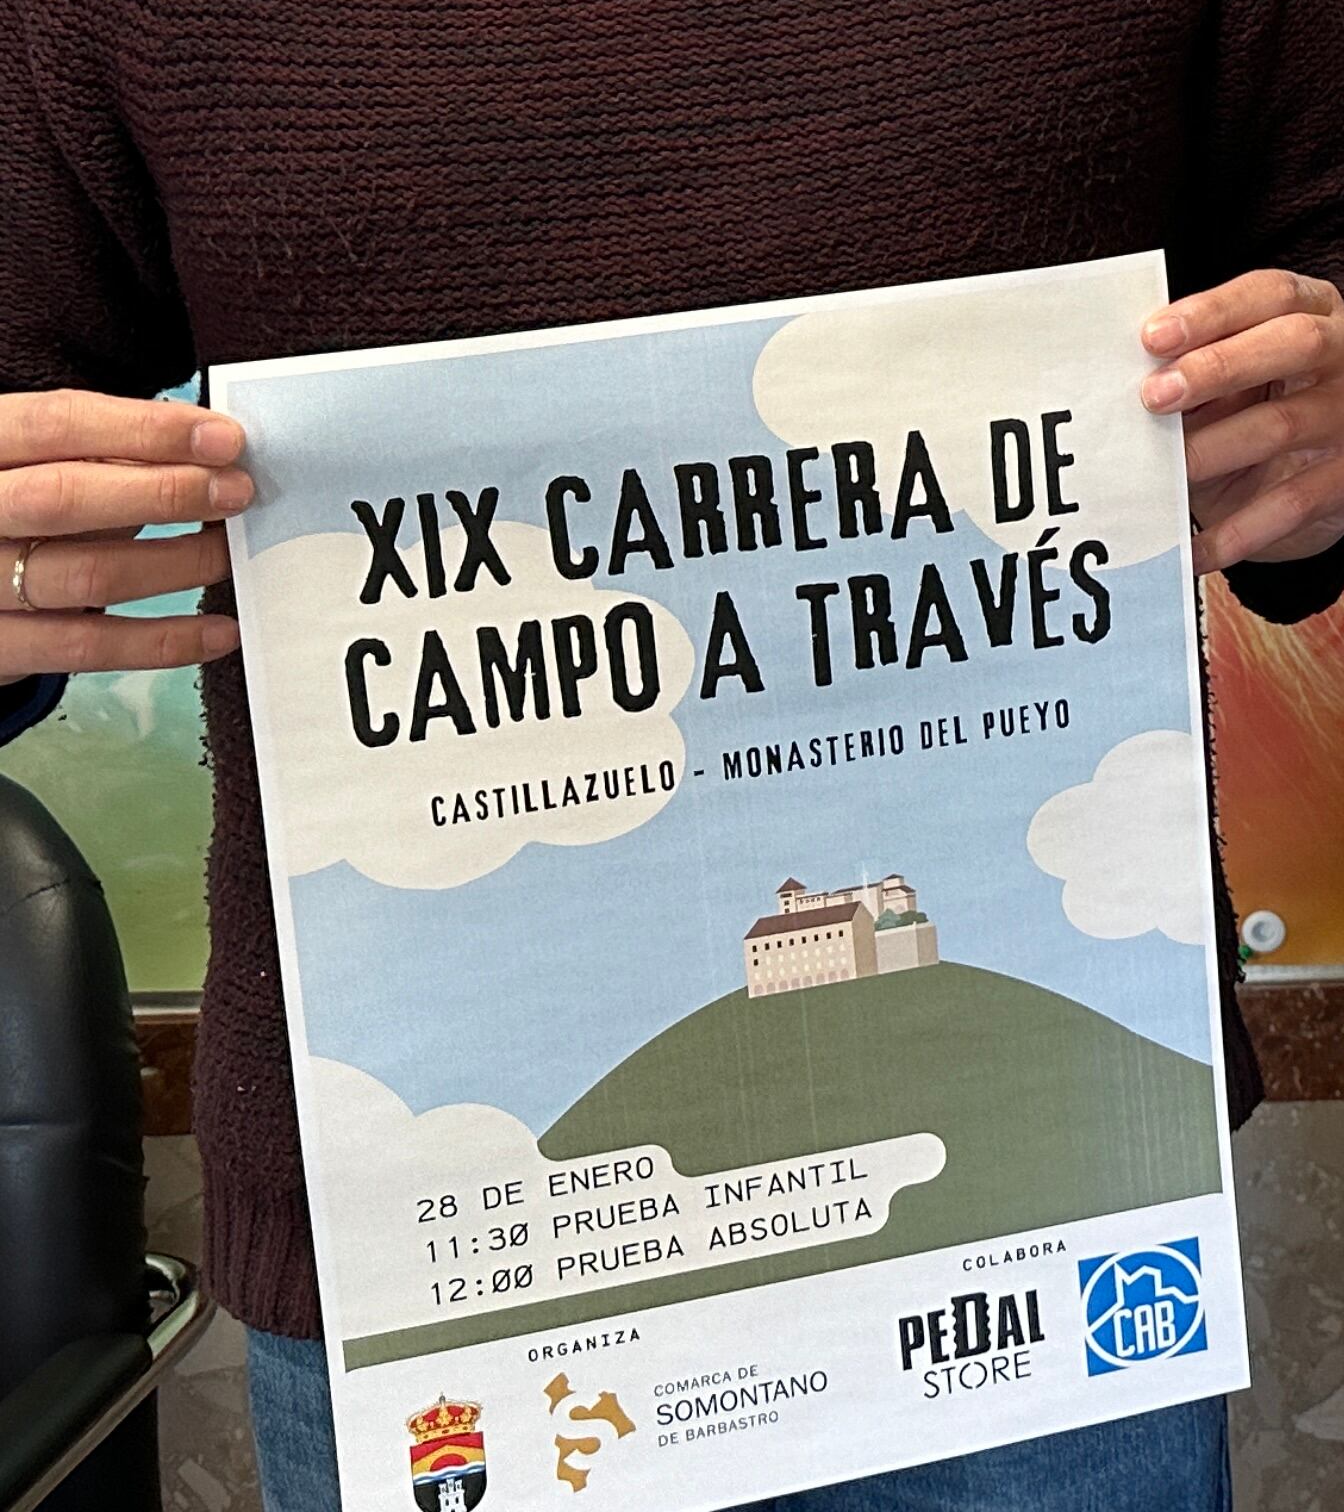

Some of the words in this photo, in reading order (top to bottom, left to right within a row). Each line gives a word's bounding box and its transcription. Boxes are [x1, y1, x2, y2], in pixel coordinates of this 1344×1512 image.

[350, 486, 512, 605] XIX
[545, 430, 955, 580] CARRERA
[990, 409, 1080, 525] DE
[344, 601, 661, 748] CAMPO
[699, 590, 766, 700] A
[796, 528, 1112, 688] TRAVÉS
[431, 760, 675, 827] CASTILLAZUELO
[722, 724, 904, 781] MONASTERIO
[920, 715, 968, 750] DEL
[982, 699, 1070, 740] PUEYO
[417, 1194, 458, 1223] 28
[482, 1180, 524, 1211] DE
[548, 1156, 654, 1197] ENERO
[427, 1222, 528, 1263] 11:30
[553, 1193, 680, 1239] PRUEBA
[704, 1158, 868, 1209] INFANTIL
[431, 1263, 533, 1305] 12:00
[557, 1234, 684, 1281] PRUEBA
[709, 1197, 872, 1251] ABSOLUTA
[962, 1239, 1067, 1272] COLABORA
[528, 1328, 640, 1363] ORGANIZA
[898, 1289, 1045, 1371] PEDAL
[1114, 1300, 1176, 1358] CAB
[653, 1371, 732, 1397] COMARCA
[737, 1364, 758, 1380] DE
[655, 1370, 828, 1427] SOMONTANO
[923, 1350, 1031, 1399] STORE
[657, 1431, 679, 1448] DE
[685, 1411, 779, 1441] BARBASTRO
